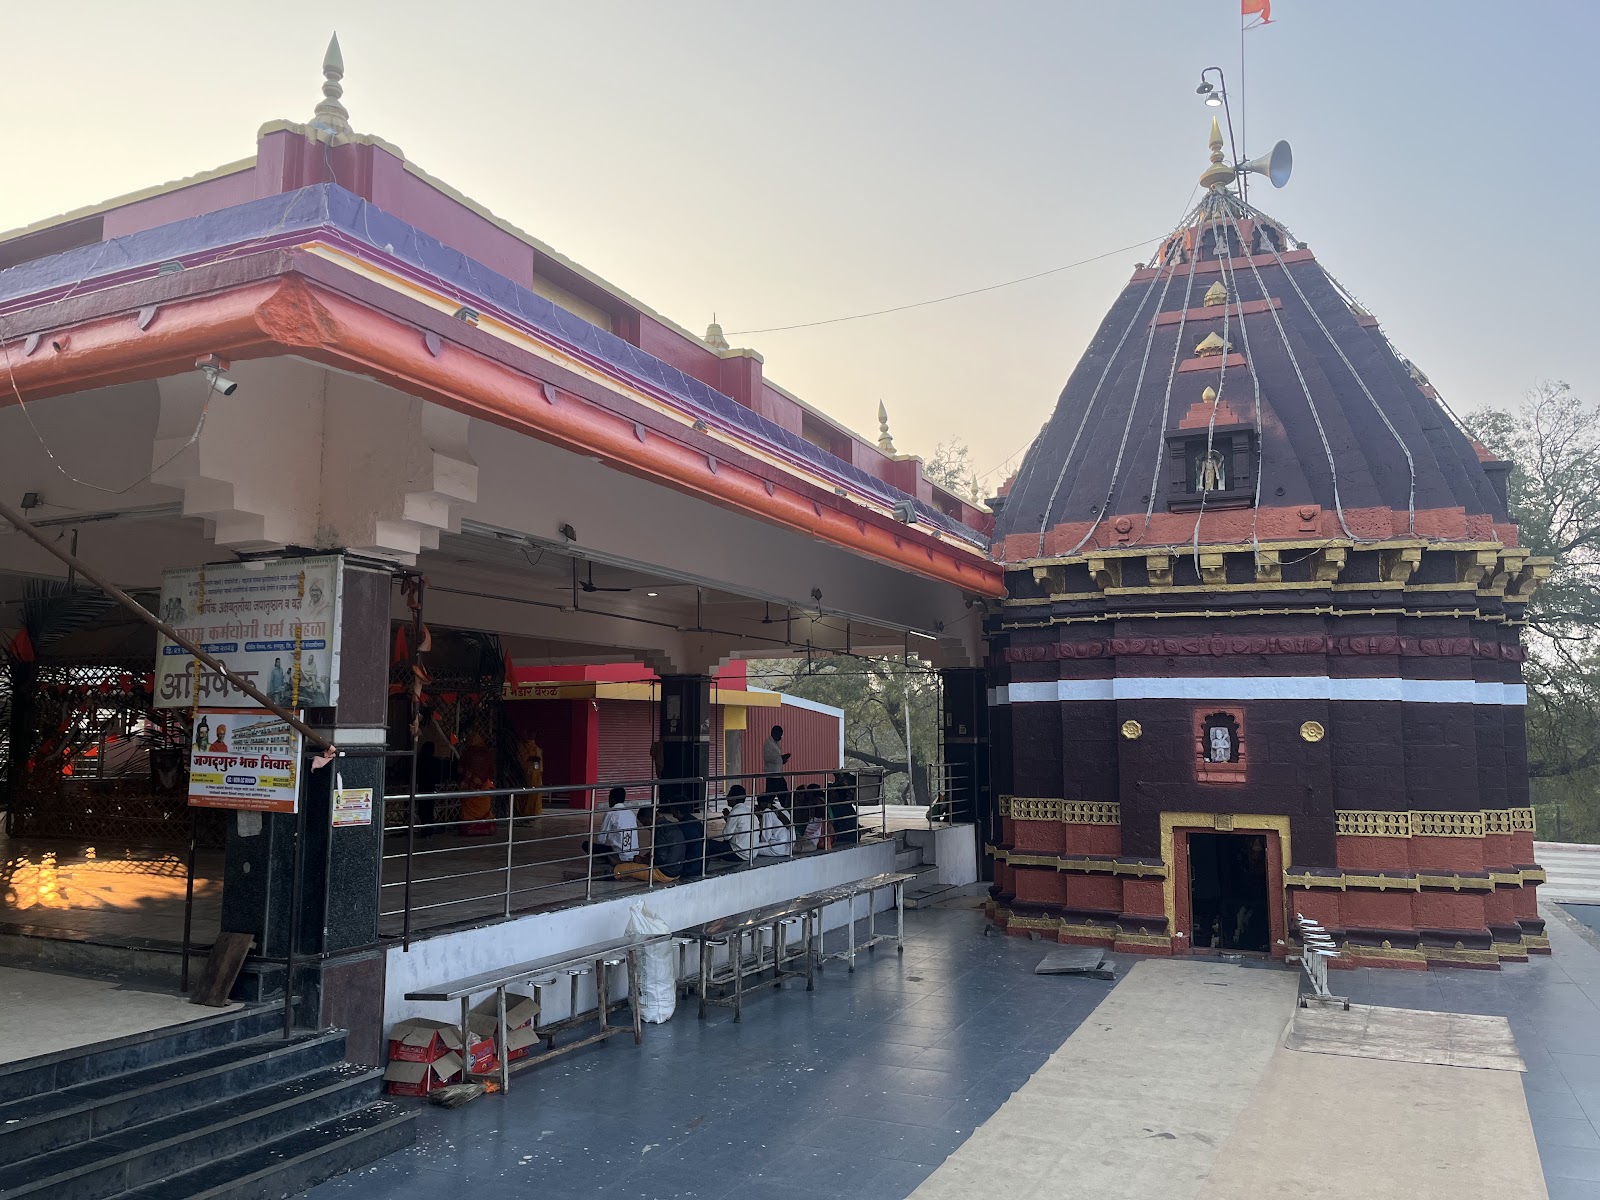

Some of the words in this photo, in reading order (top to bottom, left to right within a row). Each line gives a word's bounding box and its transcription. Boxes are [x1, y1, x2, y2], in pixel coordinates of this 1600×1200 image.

[201, 598, 216, 614] ार्षिक
[219, 597, 252, 617] अक्षयतृतीया
[253, 599, 283, 615] जपानुष्ठान
[208, 619, 259, 640] कर्मयोगी
[263, 619, 285, 638] धर्म
[288, 617, 327, 638] सोहळा
[193, 755, 238, 772] जगद्गुरु
[239, 756, 259, 769] भक्त
